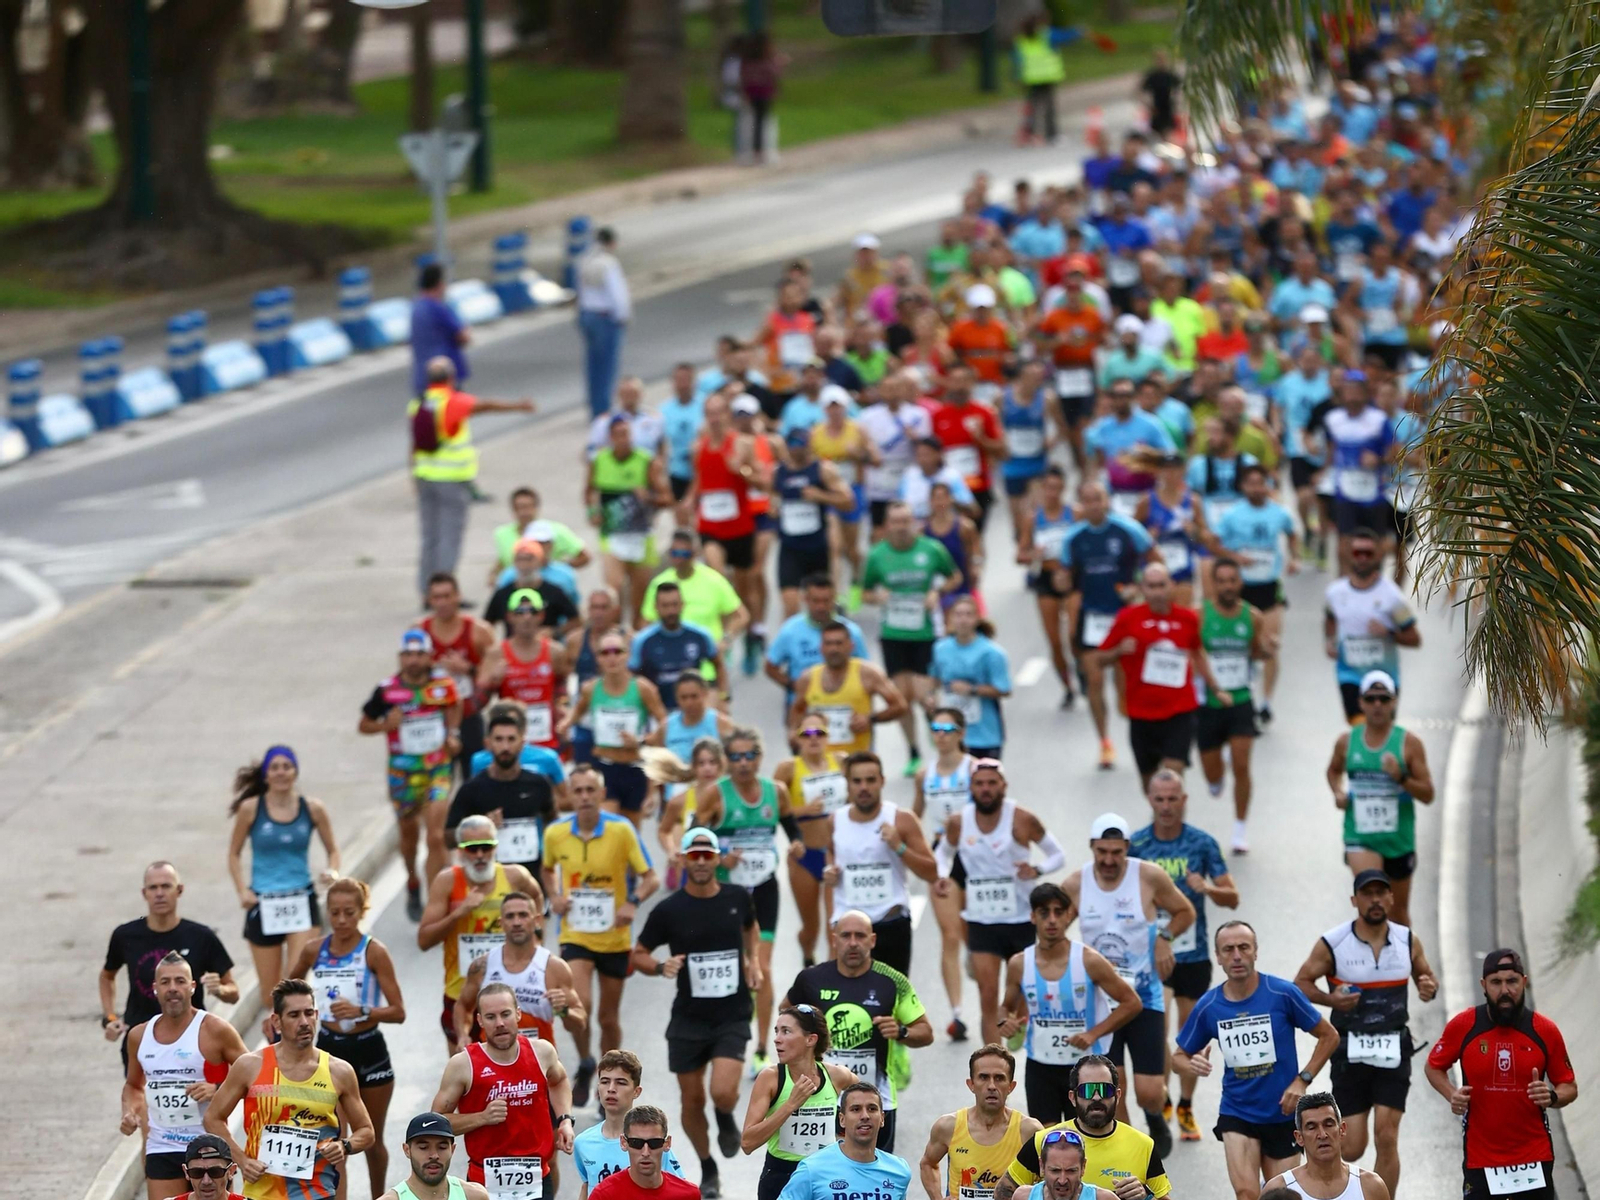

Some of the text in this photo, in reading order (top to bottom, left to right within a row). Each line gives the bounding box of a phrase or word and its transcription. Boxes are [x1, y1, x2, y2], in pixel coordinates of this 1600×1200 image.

[852, 876, 886, 889] 6006
[698, 967, 733, 980] 9785
[1220, 1020, 1233, 1031] 43
[1225, 1030, 1270, 1049] 11053
[1358, 1038, 1392, 1050] 1917
[496, 1078, 539, 1094] Triatlón
[154, 1095, 190, 1109] 1352
[509, 1097, 533, 1107] del Sol
[265, 1125, 281, 1134] 43
[791, 1121, 826, 1137] 1281
[266, 1138, 312, 1160] 11111
[485, 1158, 502, 1169] 43
[495, 1171, 534, 1187] 1729
[961, 1187, 975, 1199] 43
